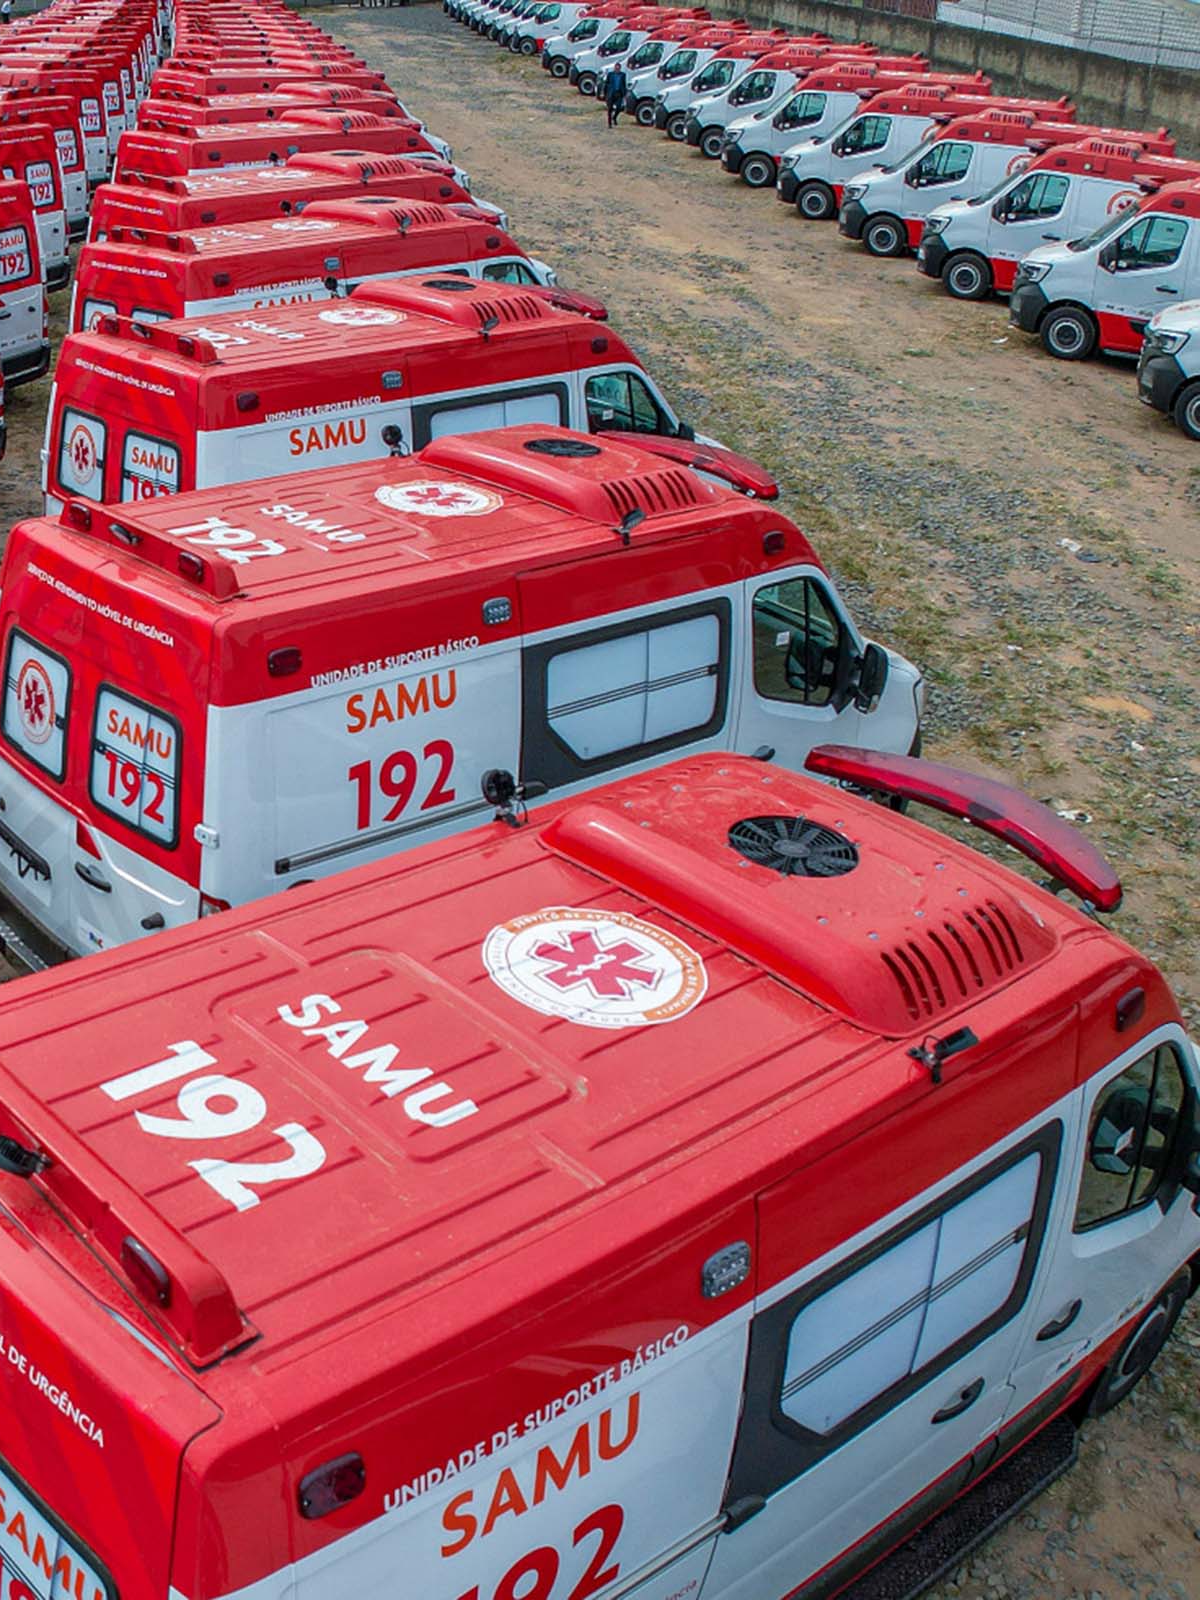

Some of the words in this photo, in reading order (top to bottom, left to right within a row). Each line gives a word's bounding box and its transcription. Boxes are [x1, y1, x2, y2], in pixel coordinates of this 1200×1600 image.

[33, 183, 51, 202] 192
[0, 234, 24, 250] SAMU
[0, 252, 25, 277] 192
[131, 446, 175, 474] SAMU
[289, 418, 366, 457] SAMU
[167, 515, 288, 565] 192
[258, 503, 367, 544] SAMU
[310, 663, 366, 688] UNIDADE
[367, 658, 382, 673] DE
[384, 645, 437, 670] SUPORTE
[437, 634, 480, 657] BÁSICO
[346, 668, 458, 734] SAMU
[106, 708, 173, 760] SAMU
[104, 750, 165, 824] 192
[347, 738, 456, 831] 192
[276, 992, 480, 1128] SAMU
[99, 1039, 328, 1213] 192
[7, 1345, 28, 1375] DE
[28, 1365, 105, 1448] URGÊNCIA
[383, 1440, 486, 1514] UNIDADE
[490, 1422, 519, 1456] DE
[522, 1367, 616, 1435] SUPORTE
[619, 1324, 690, 1379] BÁSICO
[440, 1391, 641, 1558] SAMU
[454, 1502, 626, 1600] 92
